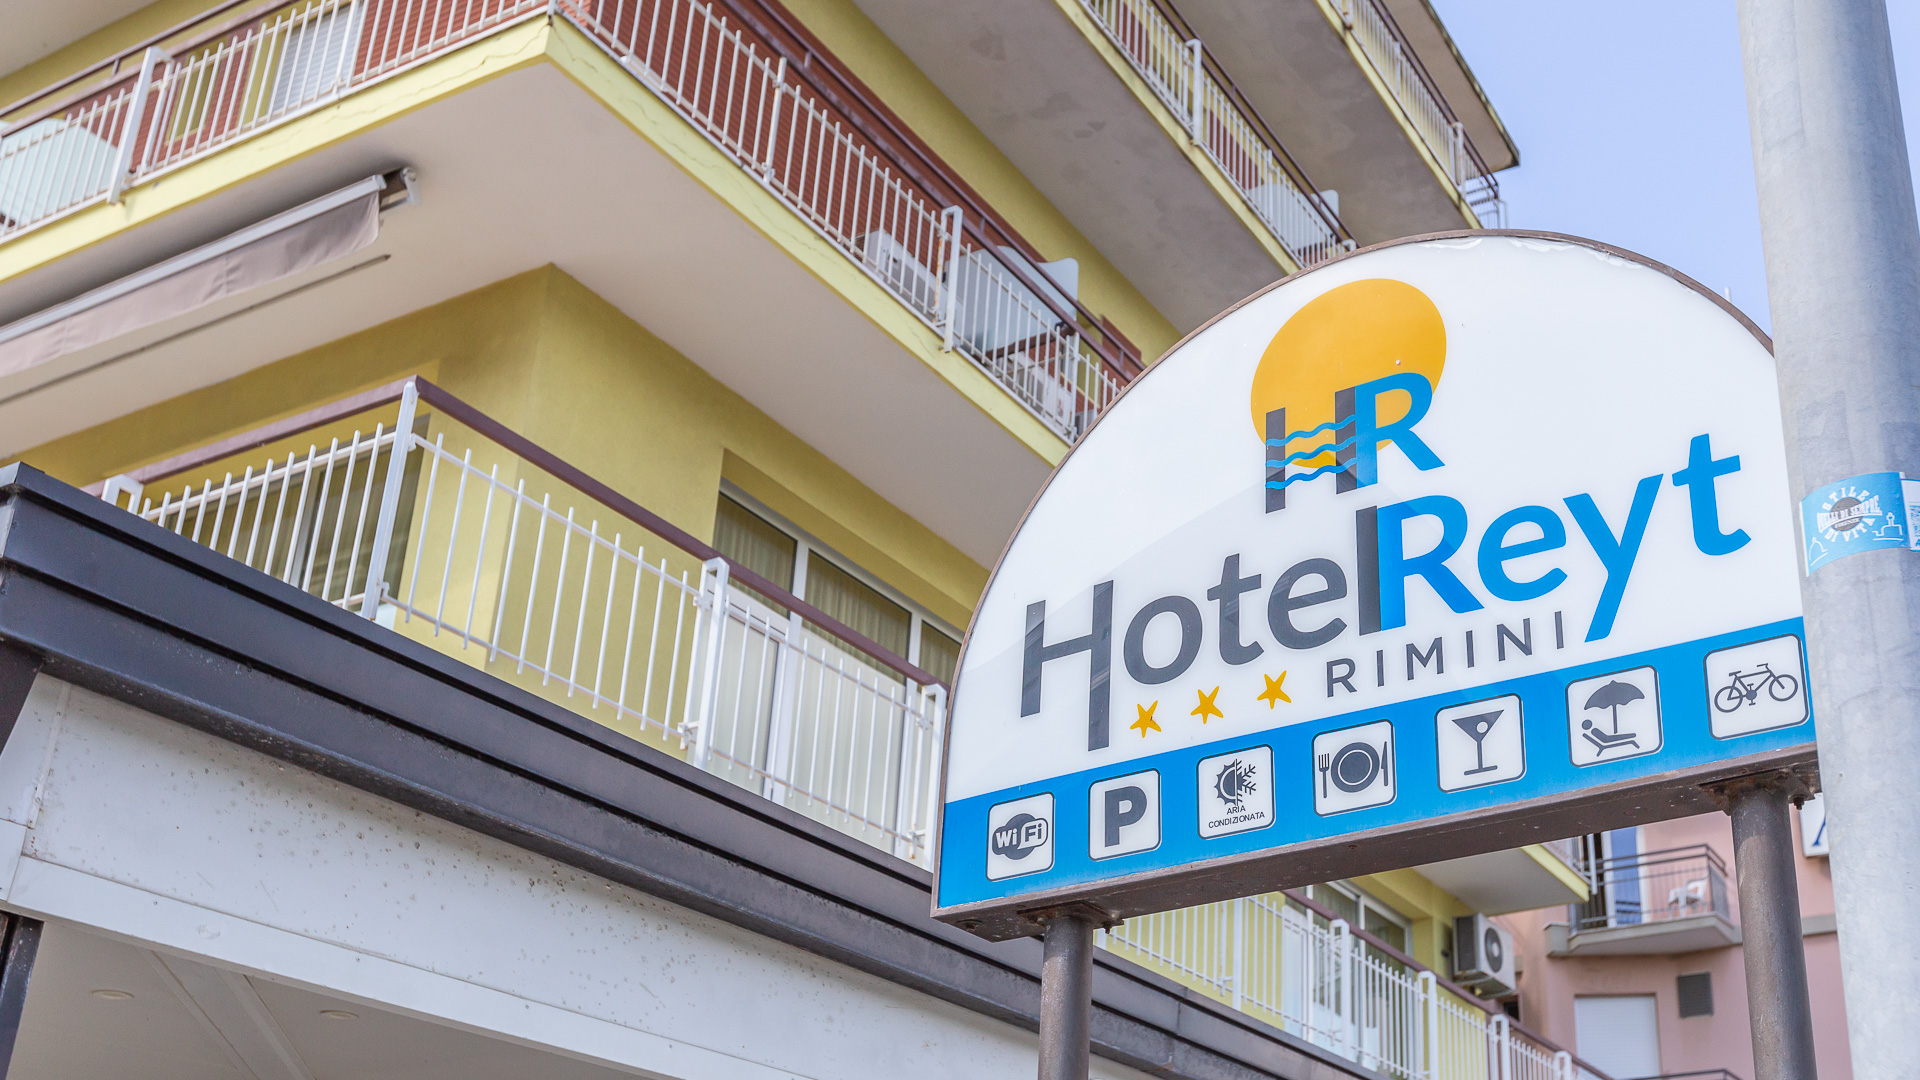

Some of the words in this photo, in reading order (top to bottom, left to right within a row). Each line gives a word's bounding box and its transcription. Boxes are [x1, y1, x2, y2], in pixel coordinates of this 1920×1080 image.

[1265, 372, 1446, 514] HR
[1020, 505, 1382, 752] Hotel
[1377, 433, 1752, 643] Reyt
[1326, 610, 1565, 698] RIMINI
[1104, 785, 1148, 848] P
[1208, 811, 1266, 829] CONDIZIONATA
[1226, 805, 1246, 815] ARIA
